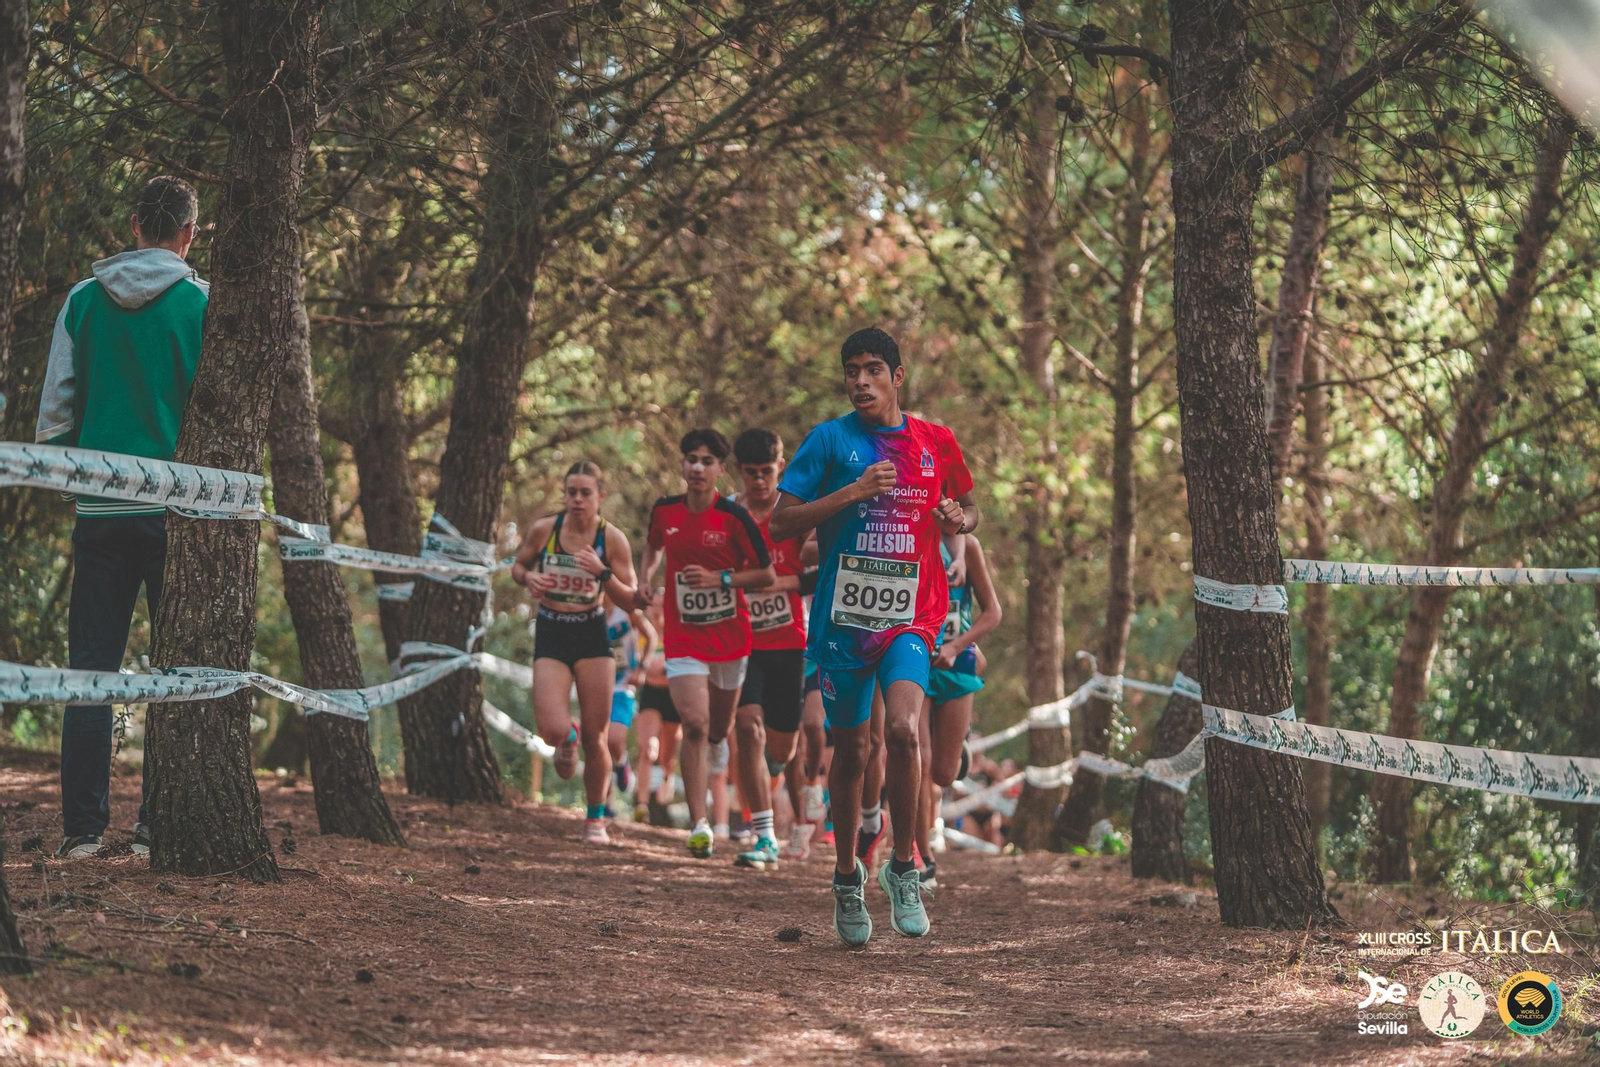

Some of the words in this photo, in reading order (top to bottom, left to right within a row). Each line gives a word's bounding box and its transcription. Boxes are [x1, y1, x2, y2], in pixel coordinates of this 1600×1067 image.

[865, 522, 909, 532] ATLETISMO
[856, 532, 915, 553] DELSUR
[290, 547, 324, 557] Sevilla
[863, 559, 901, 573] ITÁLICA
[683, 589, 732, 610] 6013
[842, 582, 911, 612] 8099
[748, 595, 786, 618] 060
[557, 611, 588, 622] PRO
